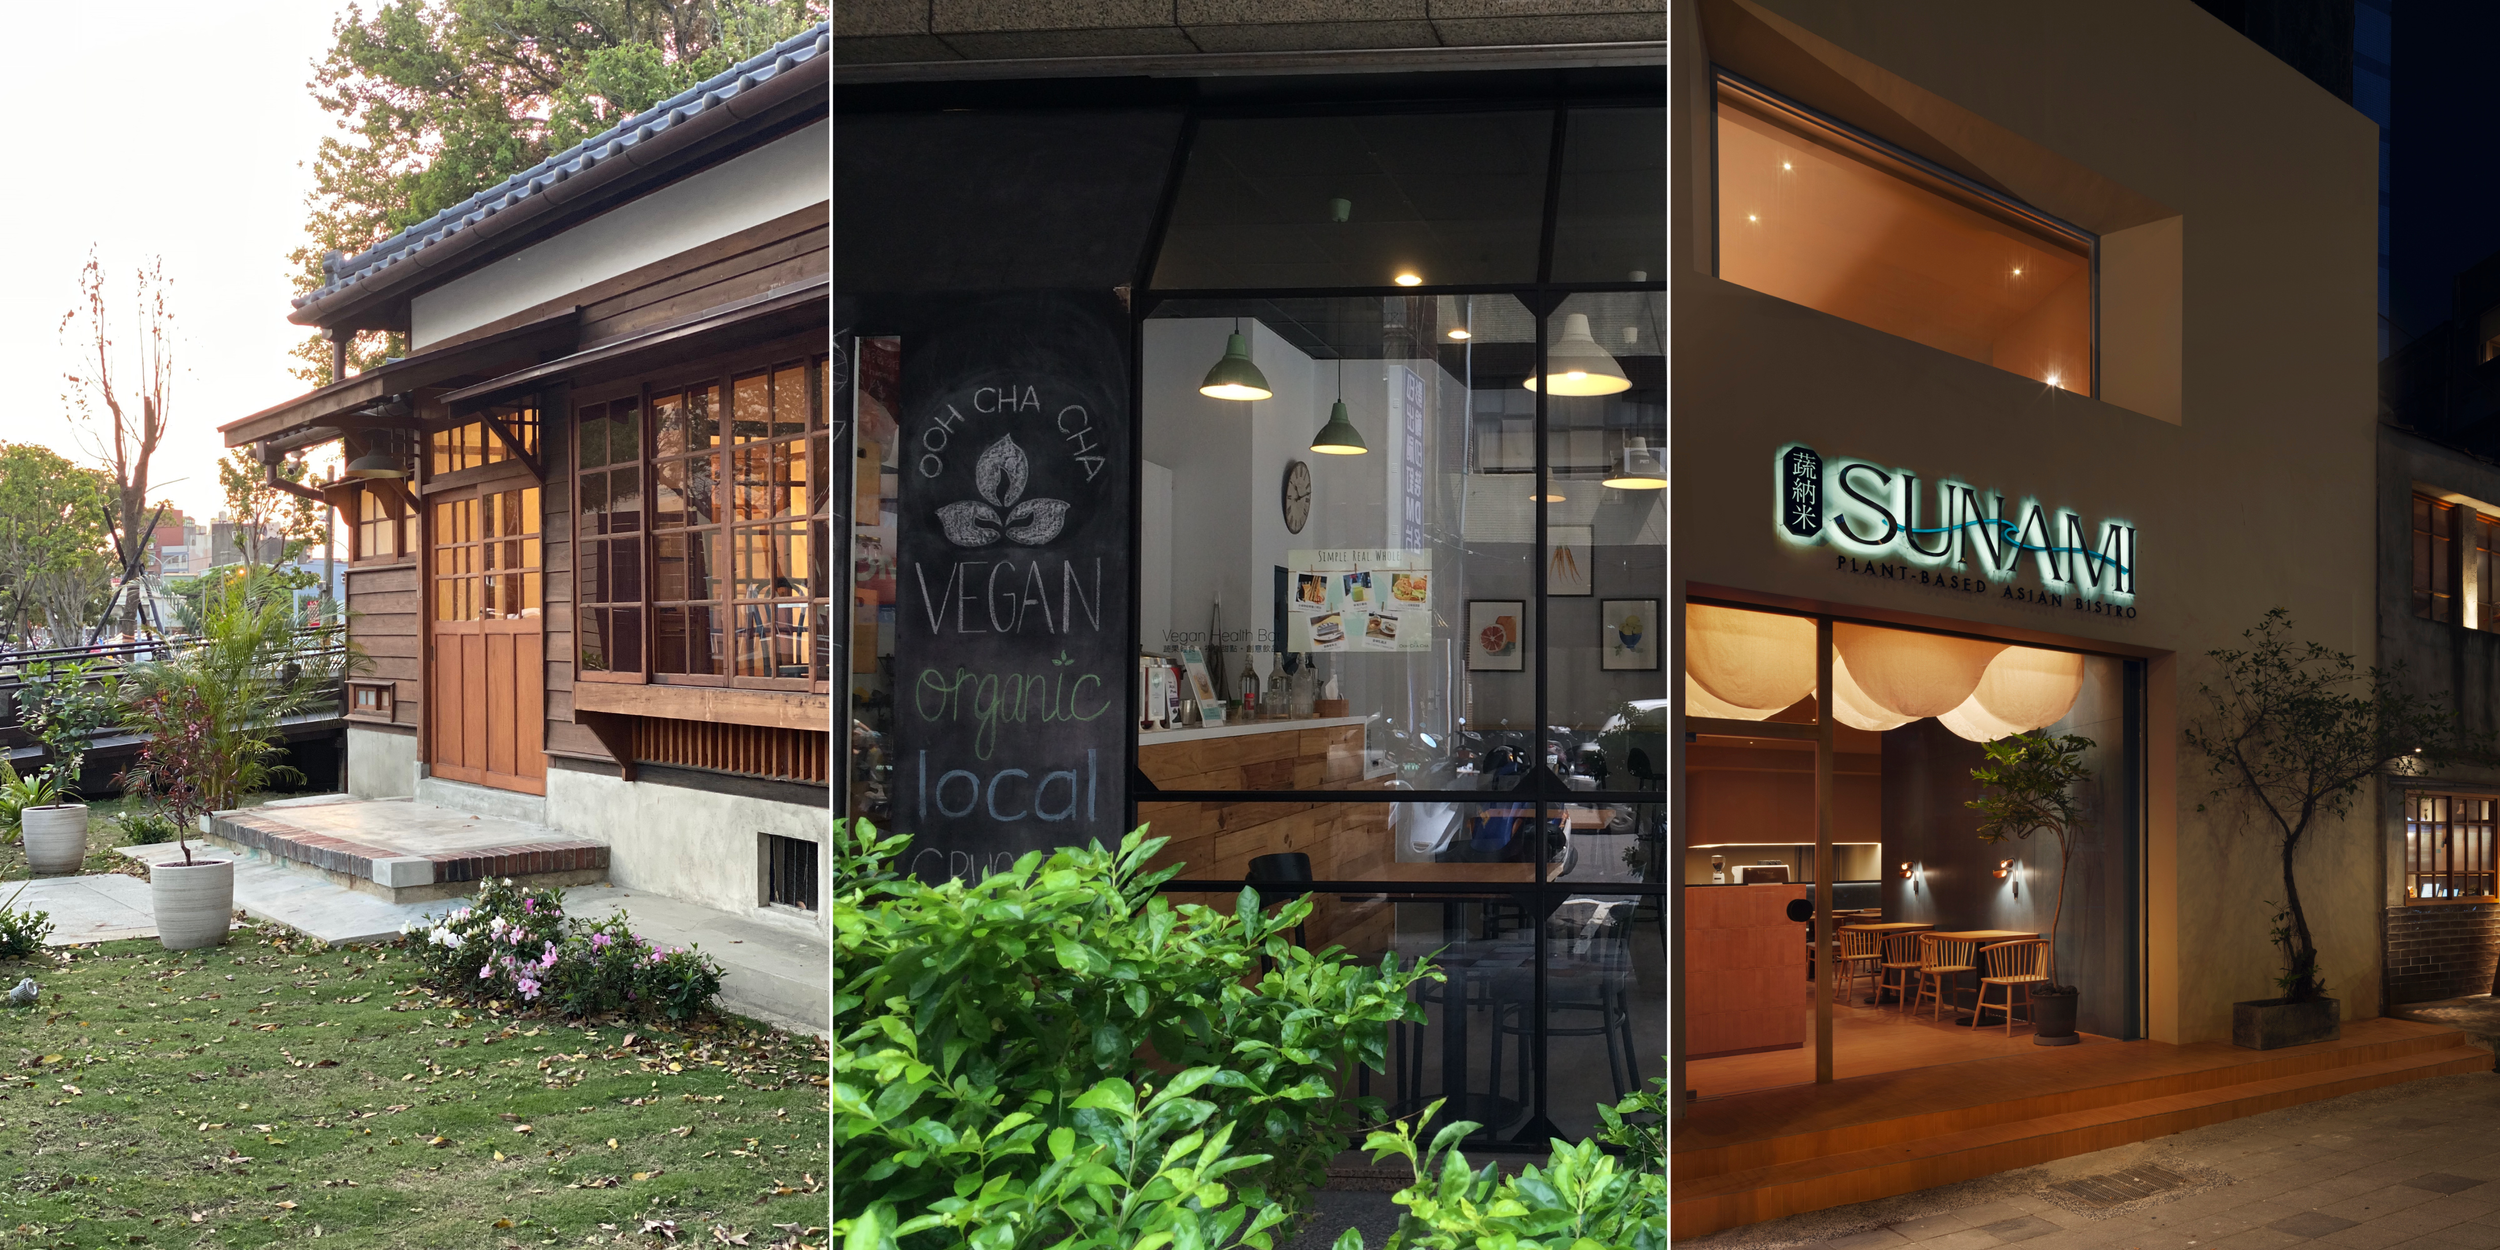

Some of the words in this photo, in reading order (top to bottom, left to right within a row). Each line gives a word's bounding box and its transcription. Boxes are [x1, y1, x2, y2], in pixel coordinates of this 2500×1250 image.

[919, 404, 965, 478] OOH
[974, 384, 1040, 413] CHA
[1057, 404, 1105, 483] CHA
[1792, 452, 1817, 530] 蔬納米
[1834, 463, 2136, 596] SUNAMI
[915, 557, 1101, 635] VEGAN
[1836, 555, 1987, 594] PLANT-BASED
[2003, 585, 2063, 608] ASIAN
[2075, 597, 2138, 620] BISTRO
[1162, 628, 1206, 645] Vegan
[1210, 628, 1254, 642] Health
[1258, 628, 1281, 642] Bar
[915, 655, 1111, 761] organic
[918, 749, 1097, 823] local
